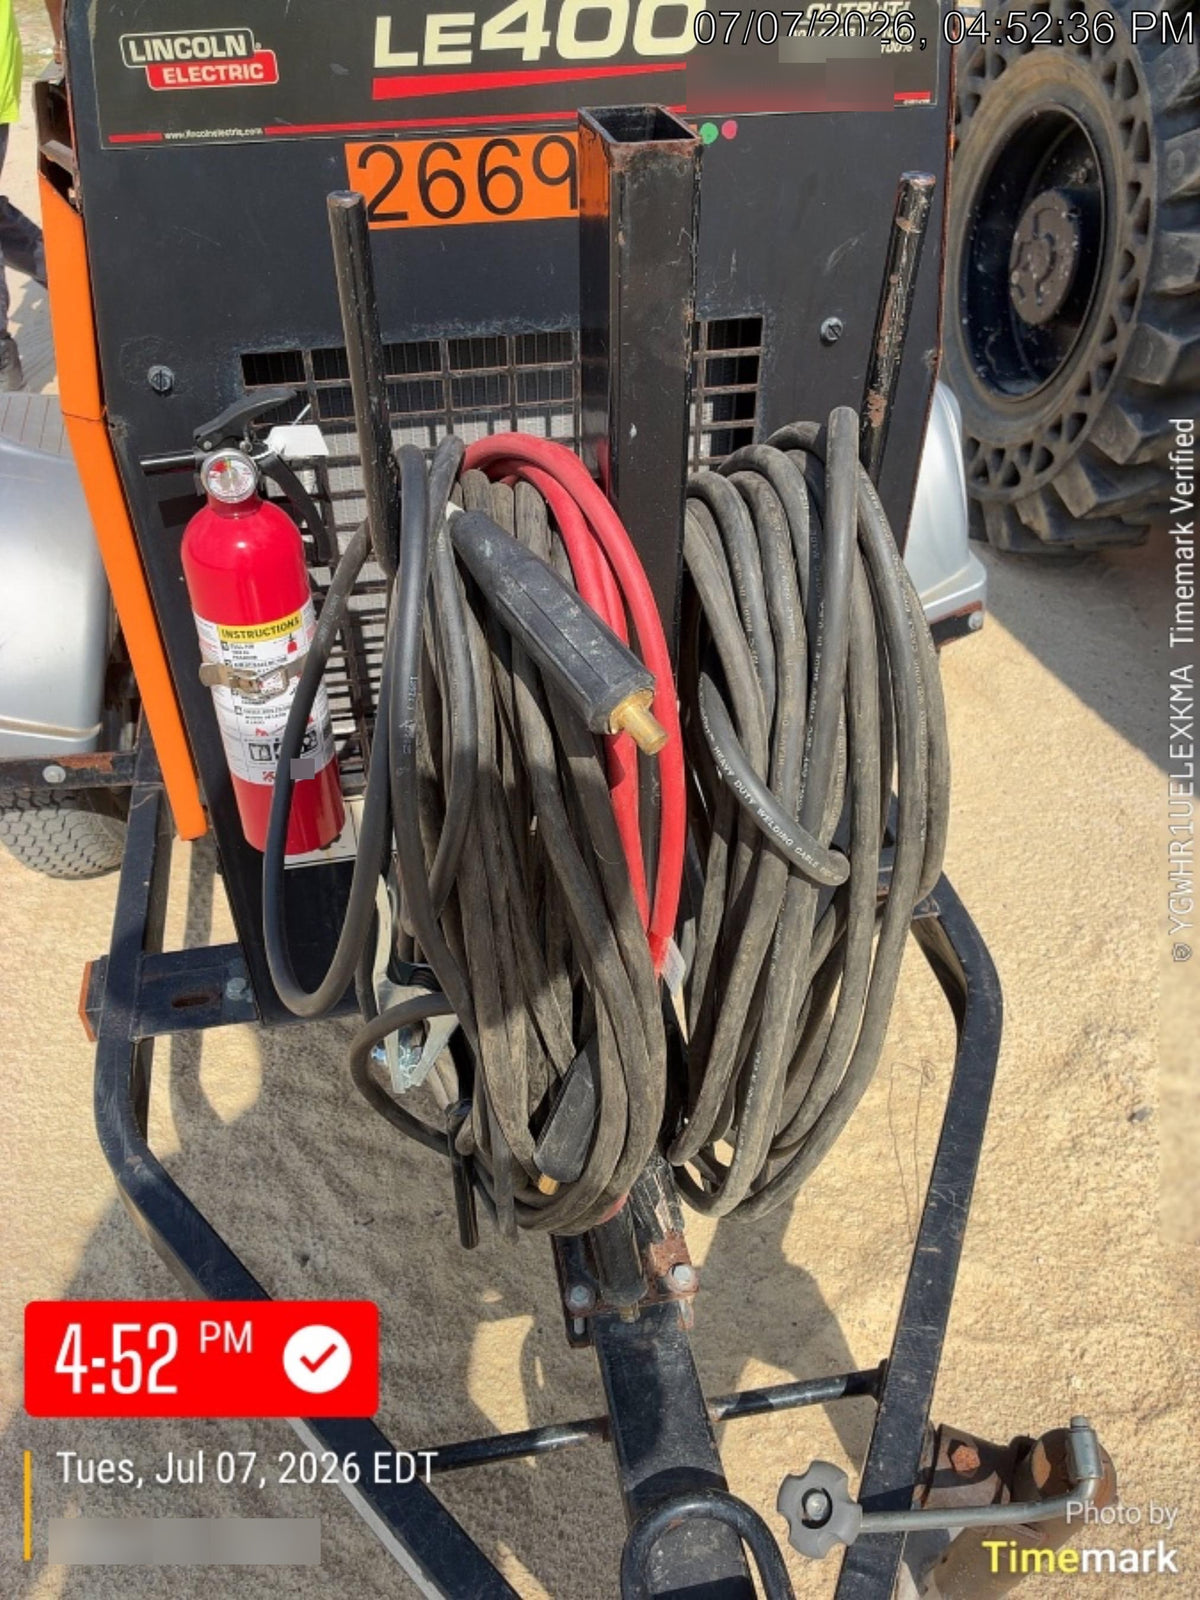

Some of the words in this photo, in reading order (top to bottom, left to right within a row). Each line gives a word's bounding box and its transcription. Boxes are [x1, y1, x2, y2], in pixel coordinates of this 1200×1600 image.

[128, 34, 248, 63] LINCOLN
[373, 0, 704, 68] LE400
[162, 63, 264, 84] ELECTRIC
[357, 134, 579, 222] 2669
[221, 616, 300, 640] INSTRUCTIONS
[713, 746, 736, 777] HEAVY
[734, 779, 755, 805] DUTY
[756, 807, 795, 846] WELDING
[794, 846, 820, 868] CABLE
